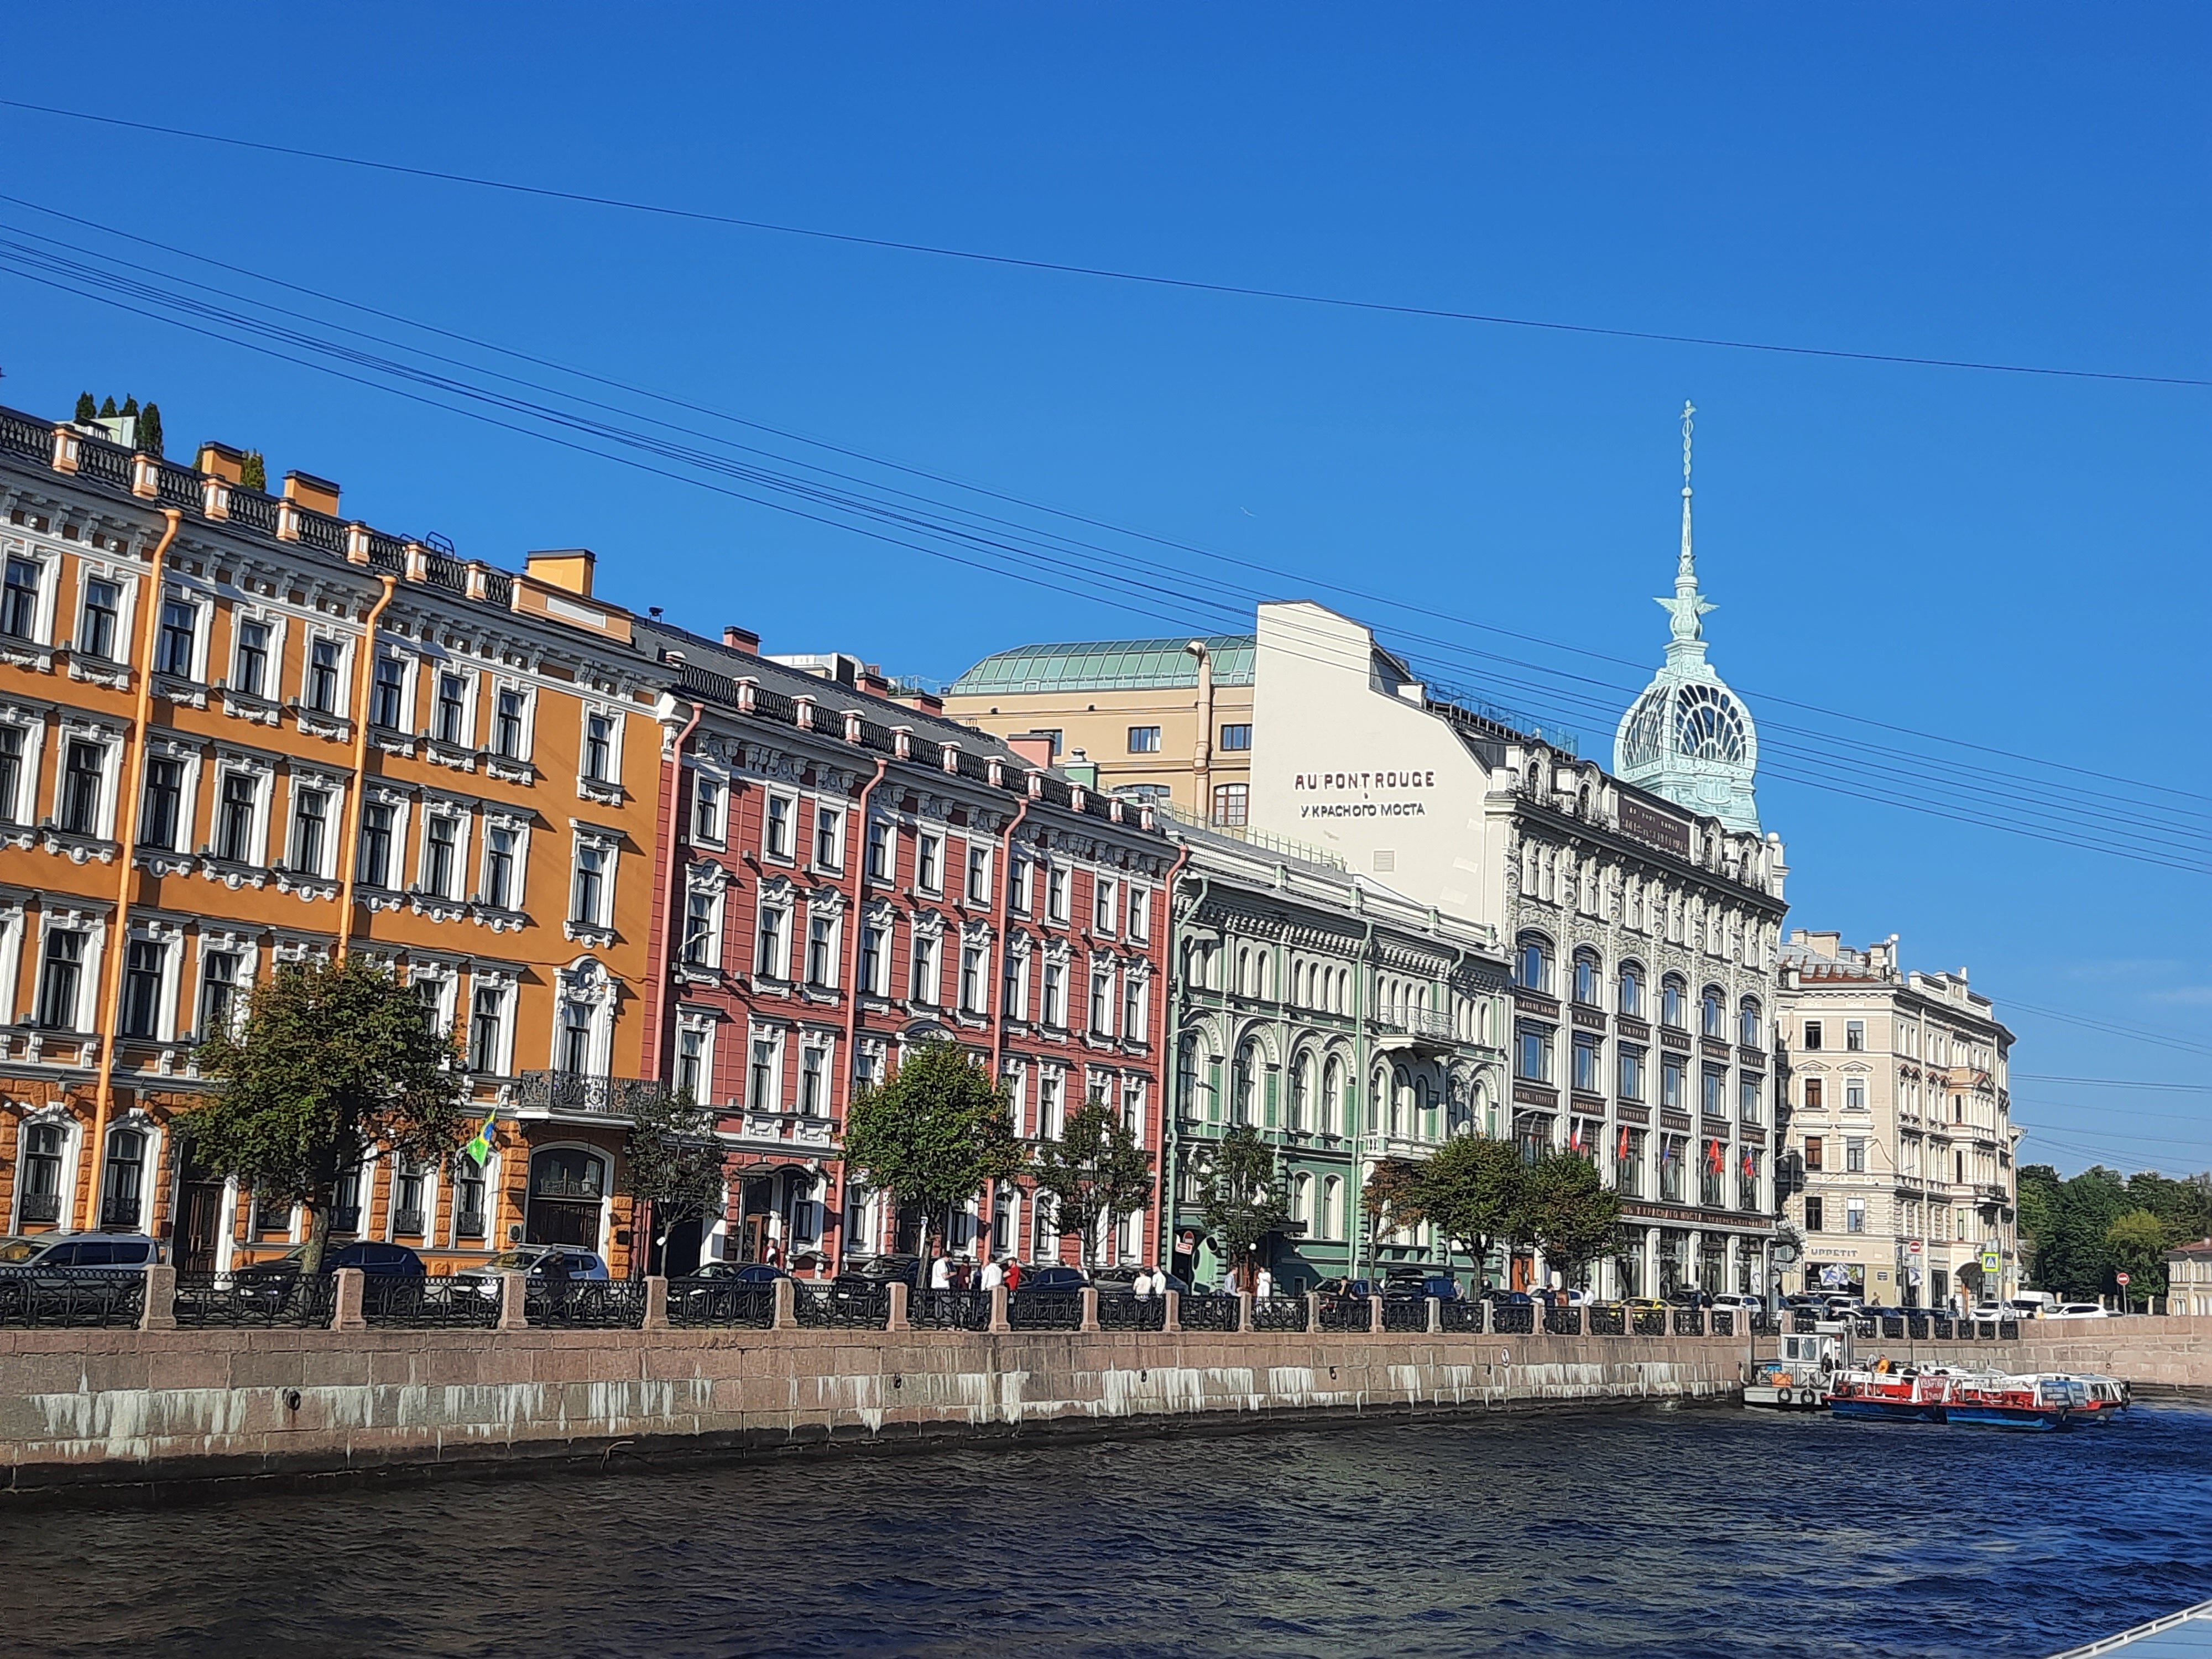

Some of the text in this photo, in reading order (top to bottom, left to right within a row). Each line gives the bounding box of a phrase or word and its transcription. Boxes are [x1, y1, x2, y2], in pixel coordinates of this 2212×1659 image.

[1295, 771, 1434, 790] AU PONT ROUGE
[1301, 803, 1425, 818] У КРАСНОГО МОСТА
